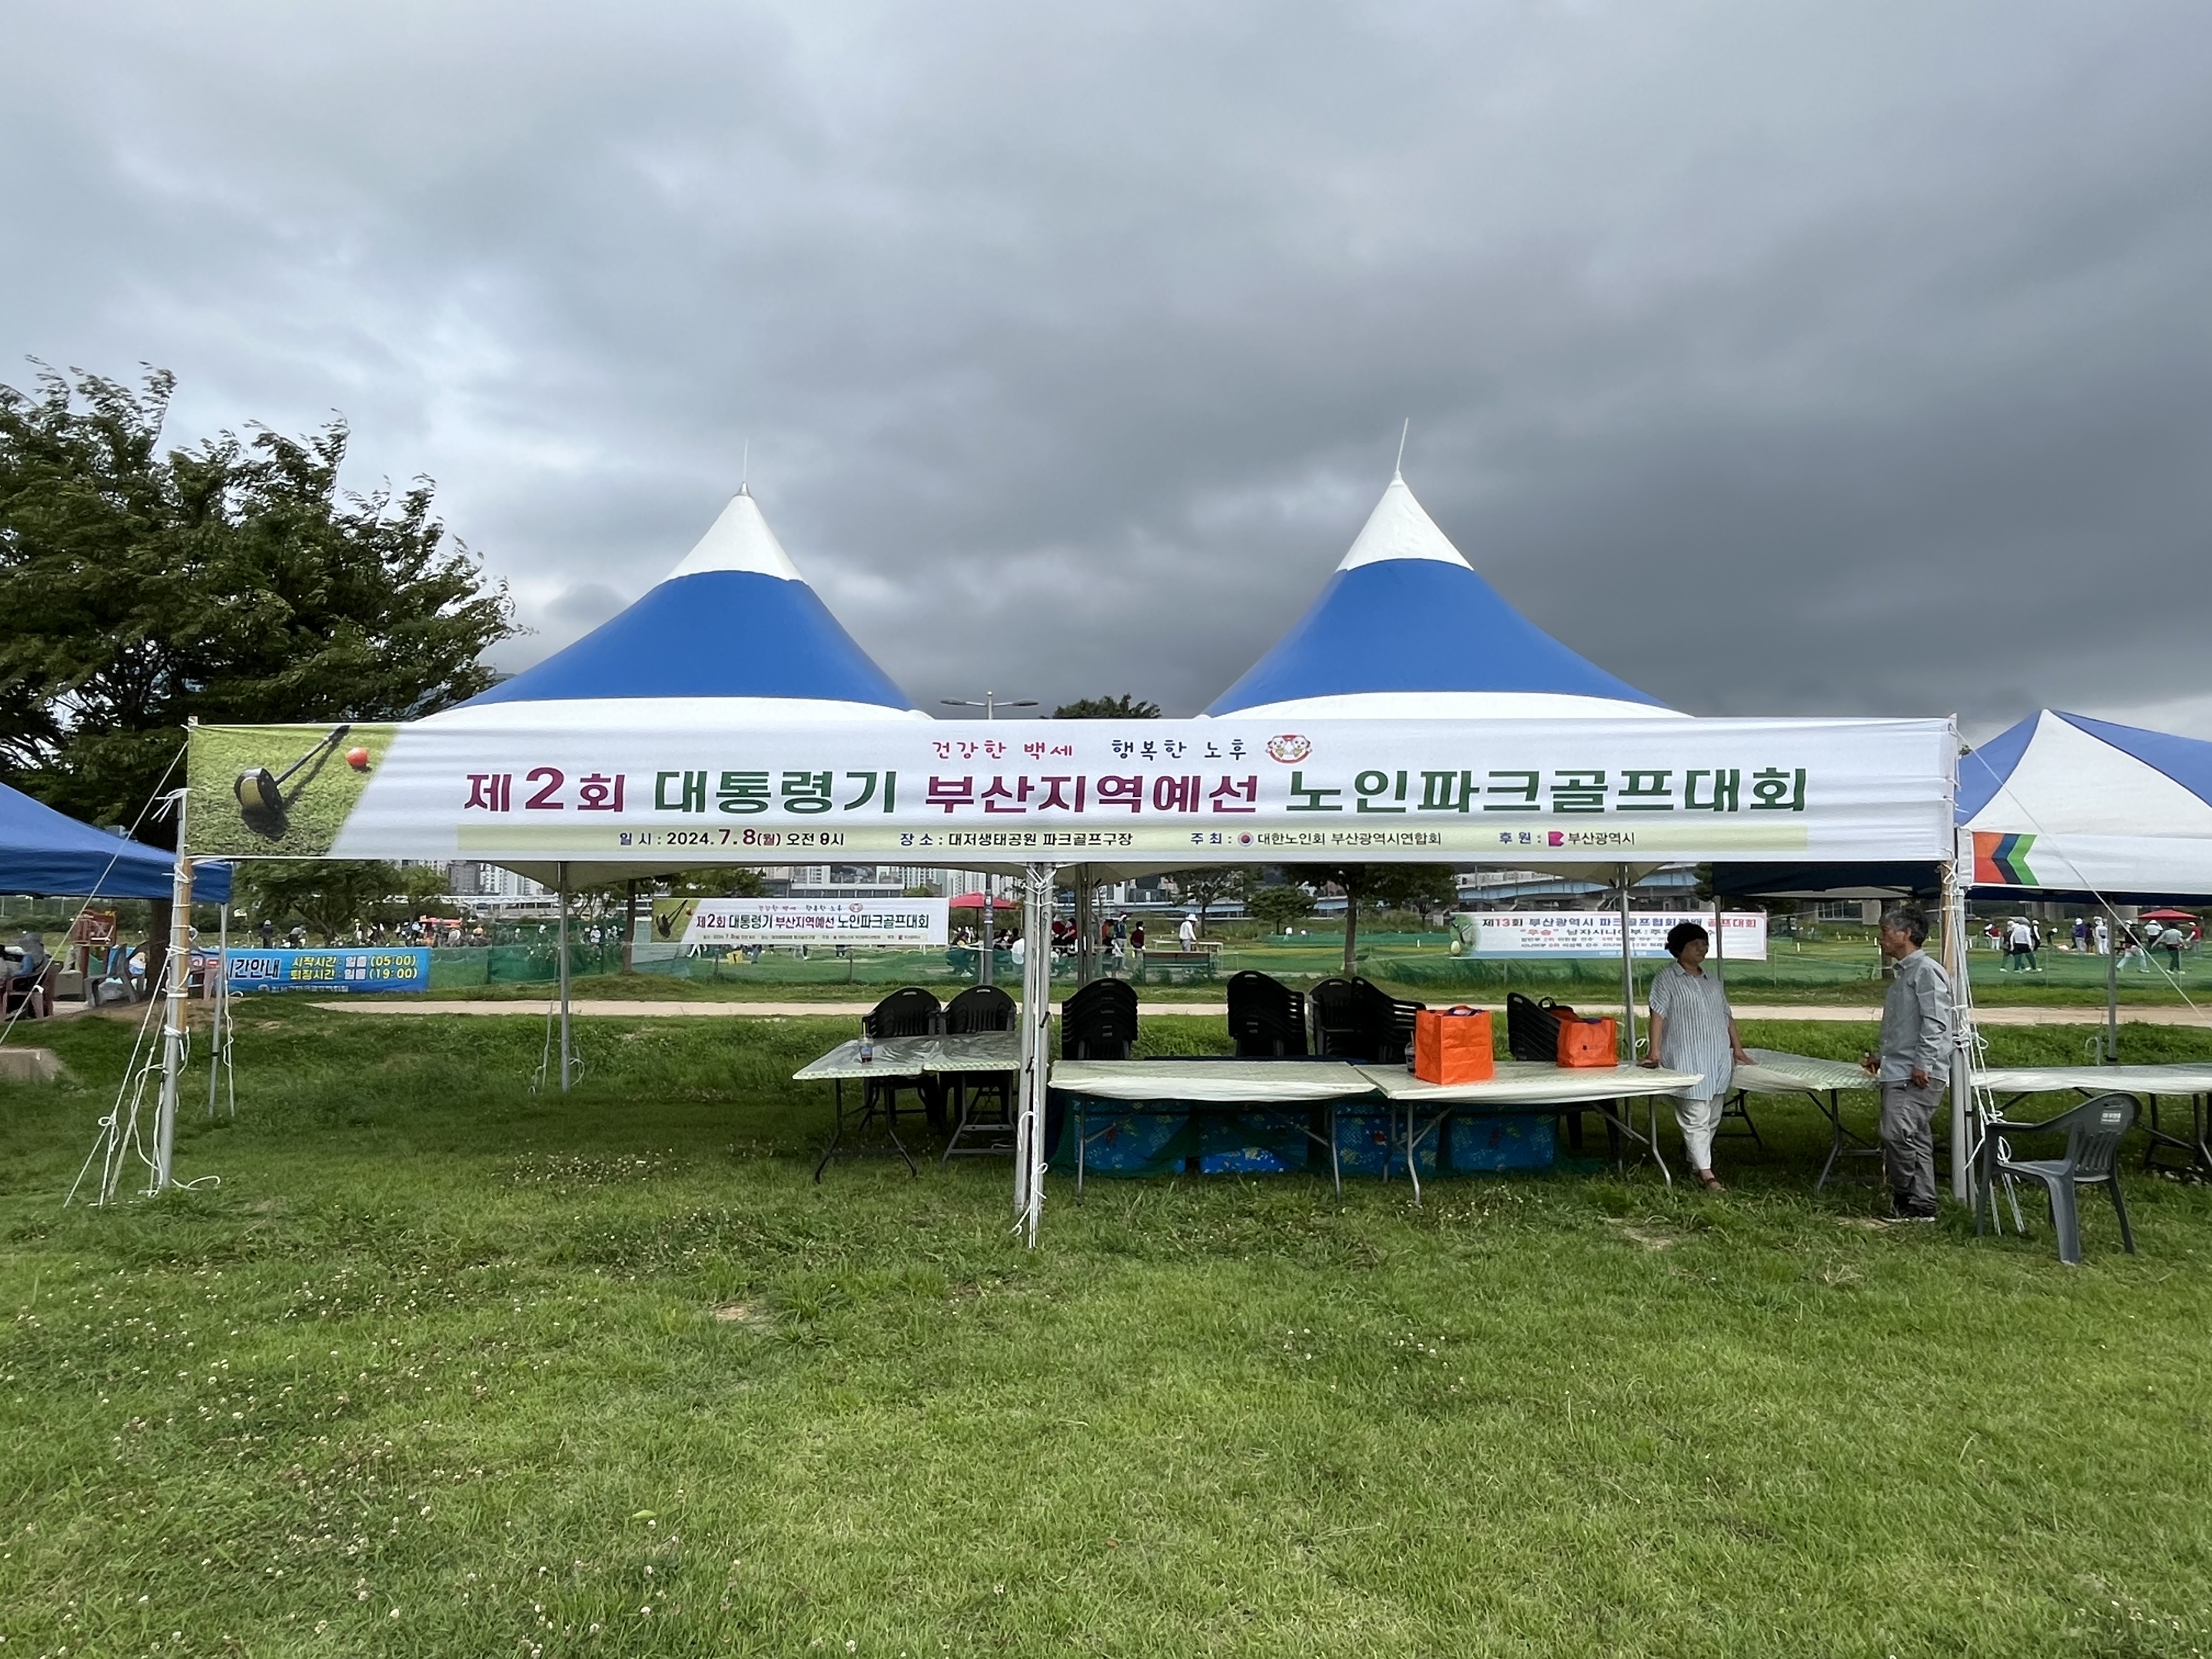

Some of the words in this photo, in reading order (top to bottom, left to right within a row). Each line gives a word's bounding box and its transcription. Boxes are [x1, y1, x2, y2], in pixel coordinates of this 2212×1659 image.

[932, 740, 1007, 759] 건강한
[1024, 742, 1072, 760] 백세
[1111, 740, 1187, 761] 행복한
[1204, 738, 1246, 761] 노후
[464, 768, 625, 812] 제2회
[655, 770, 896, 814] 대통령기
[926, 775, 1257, 814] 부산지역예선
[1285, 768, 1807, 813] 노인파크골프대회
[786, 833, 814, 846] 오전
[949, 833, 1037, 846] 대저생태공원
[1042, 833, 1133, 846] 파크골프구장
[1258, 833, 1325, 845] 대한노인회
[1331, 832, 1441, 845] 부산광역시연합회
[1568, 832, 1635, 845] 부산광역시
[696, 913, 726, 928] 제2회
[729, 915, 773, 929] 대통령기
[775, 916, 834, 929] 부산지역예선
[837, 914, 929, 929] 노인파크골프대회
[1482, 918, 1523, 927] 제13회
[1528, 918, 1593, 927] 부산광역시
